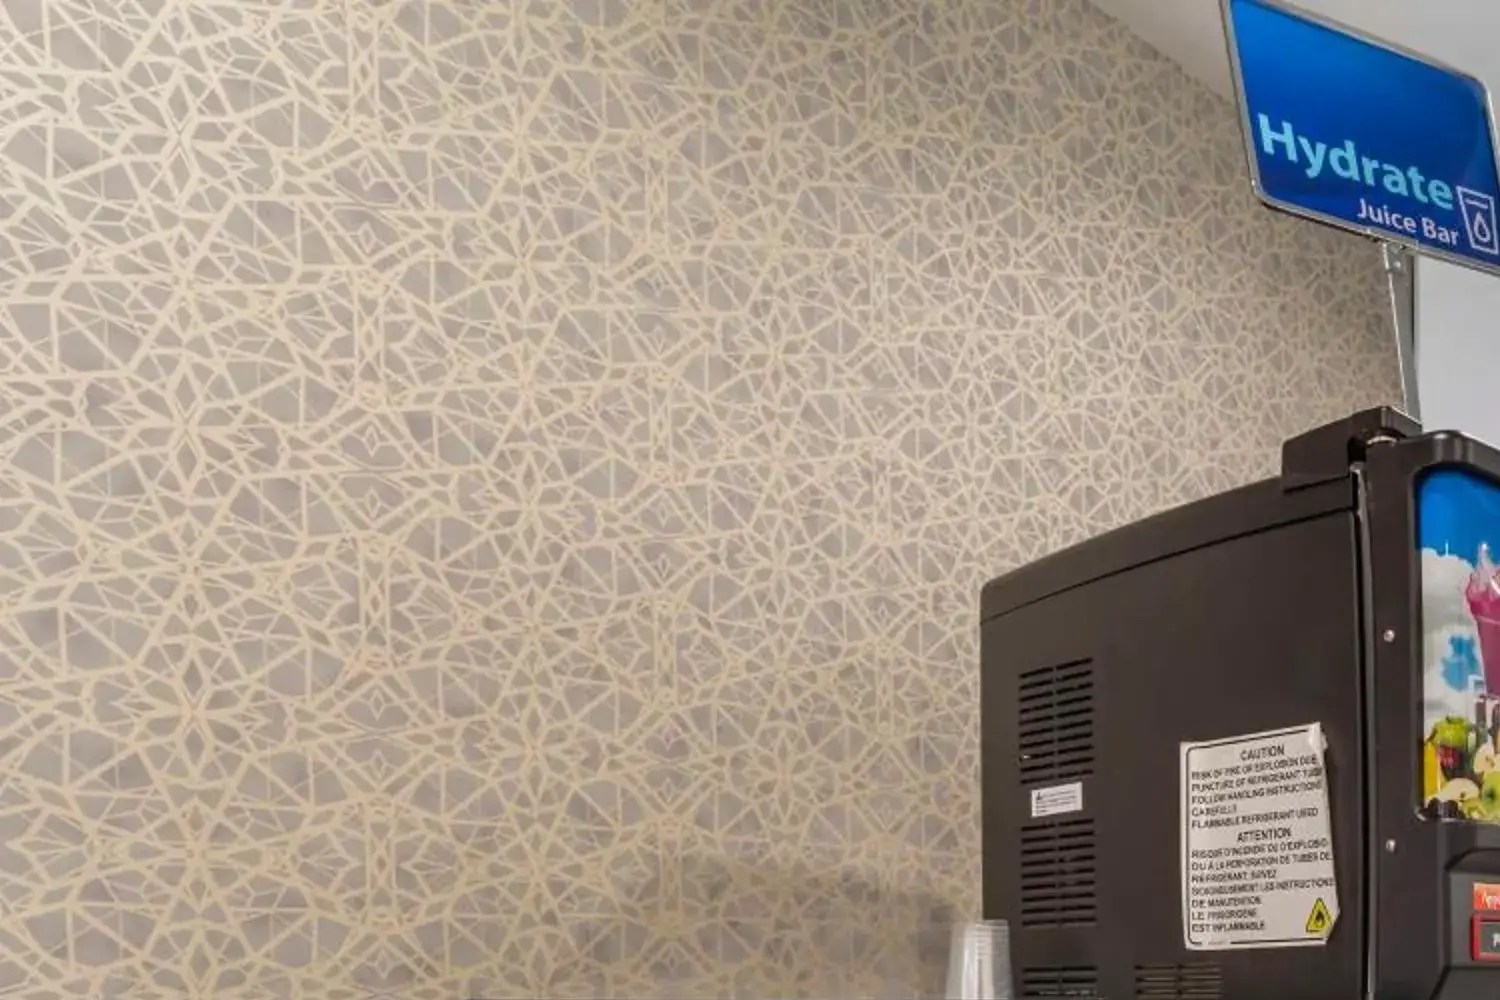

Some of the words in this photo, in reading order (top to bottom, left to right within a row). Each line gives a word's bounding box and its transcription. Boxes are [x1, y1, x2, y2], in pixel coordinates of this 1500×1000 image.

[1257, 112, 1453, 210] Hydrate
[1357, 198, 1416, 233] Juice
[1421, 216, 1459, 246] Bar
[1240, 745, 1284, 760] CAUTION
[1236, 827, 1292, 843] ATTENTION
